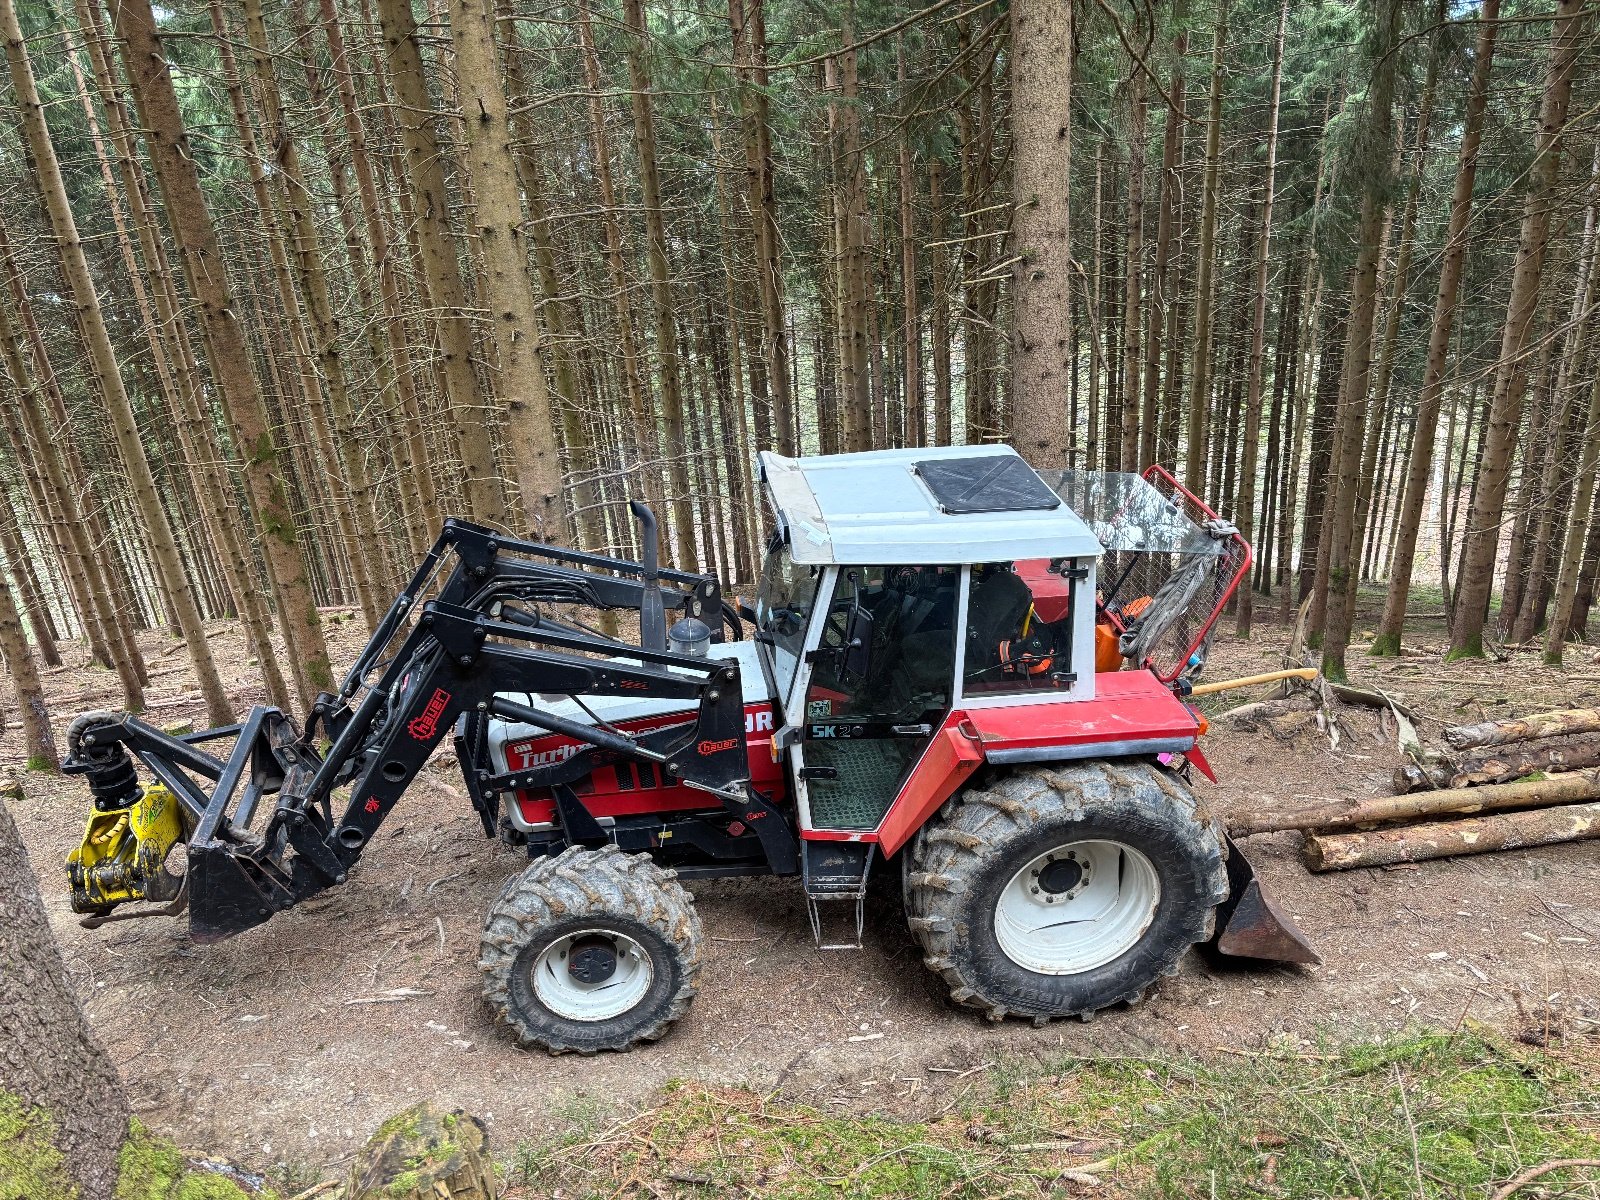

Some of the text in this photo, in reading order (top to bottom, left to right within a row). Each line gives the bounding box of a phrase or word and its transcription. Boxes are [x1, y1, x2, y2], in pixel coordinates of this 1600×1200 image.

[411, 689, 448, 737] hauer
[519, 743, 597, 768] Turb
[702, 740, 737, 753] hauer
